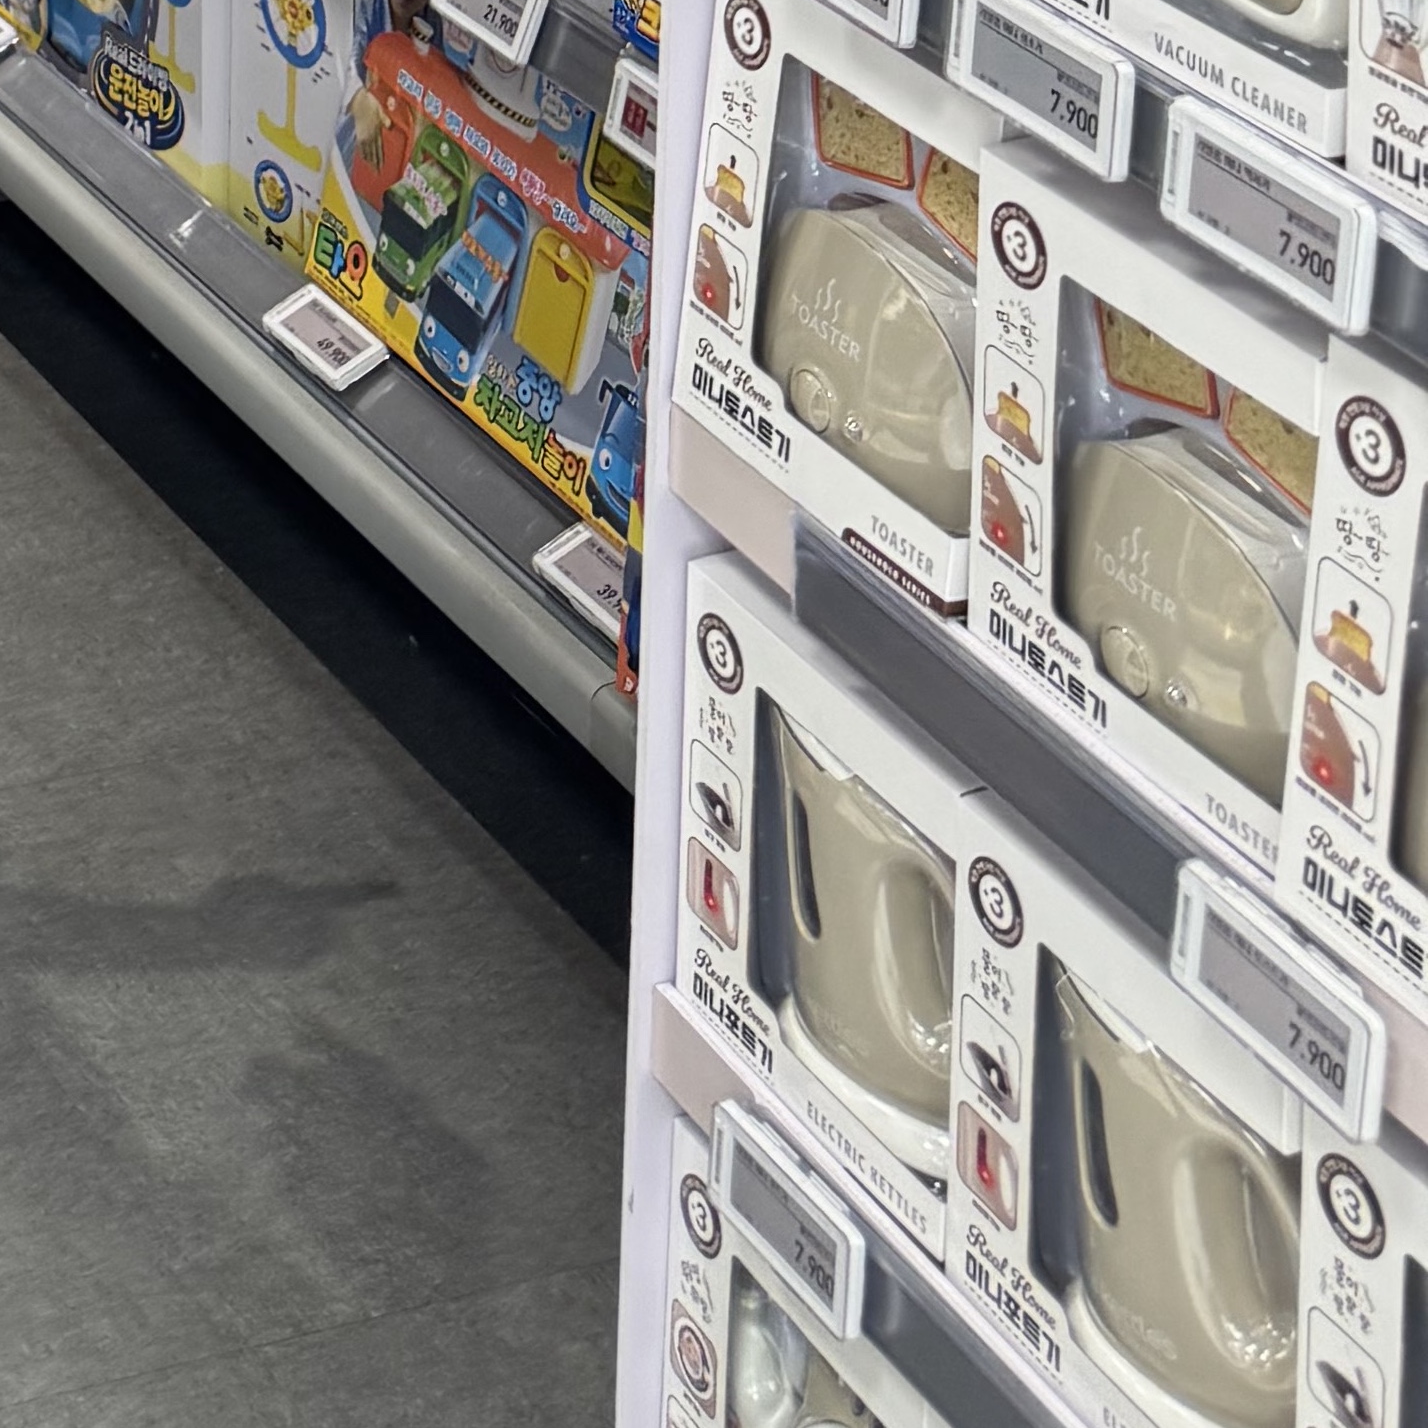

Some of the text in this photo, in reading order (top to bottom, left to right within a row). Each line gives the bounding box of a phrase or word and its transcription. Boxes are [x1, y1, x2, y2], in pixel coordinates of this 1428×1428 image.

[1153, 32, 1309, 135] VACUUM CLEANER
[313, 221, 369, 301] 타요
[790, 295, 862, 364] TOASTER
[515, 355, 562, 425] 중앙
[691, 362, 792, 464] 미니토스트기
[696, 337, 774, 413] Real Home
[869, 513, 936, 579] TOASTER
[1093, 544, 1178, 622] TOASTER
[989, 580, 1083, 669] Real Home
[987, 616, 1109, 730] 미니토스트기
[1305, 823, 1423, 932] Real Home
[693, 947, 729, 990] Real
[692, 970, 774, 1074] 미니포트기
[806, 1101, 868, 1175] ELECTRIC
[869, 1163, 928, 1235] KETTLES
[965, 1223, 1006, 1273] Real
[964, 1250, 1062, 1374] 미니포트기
